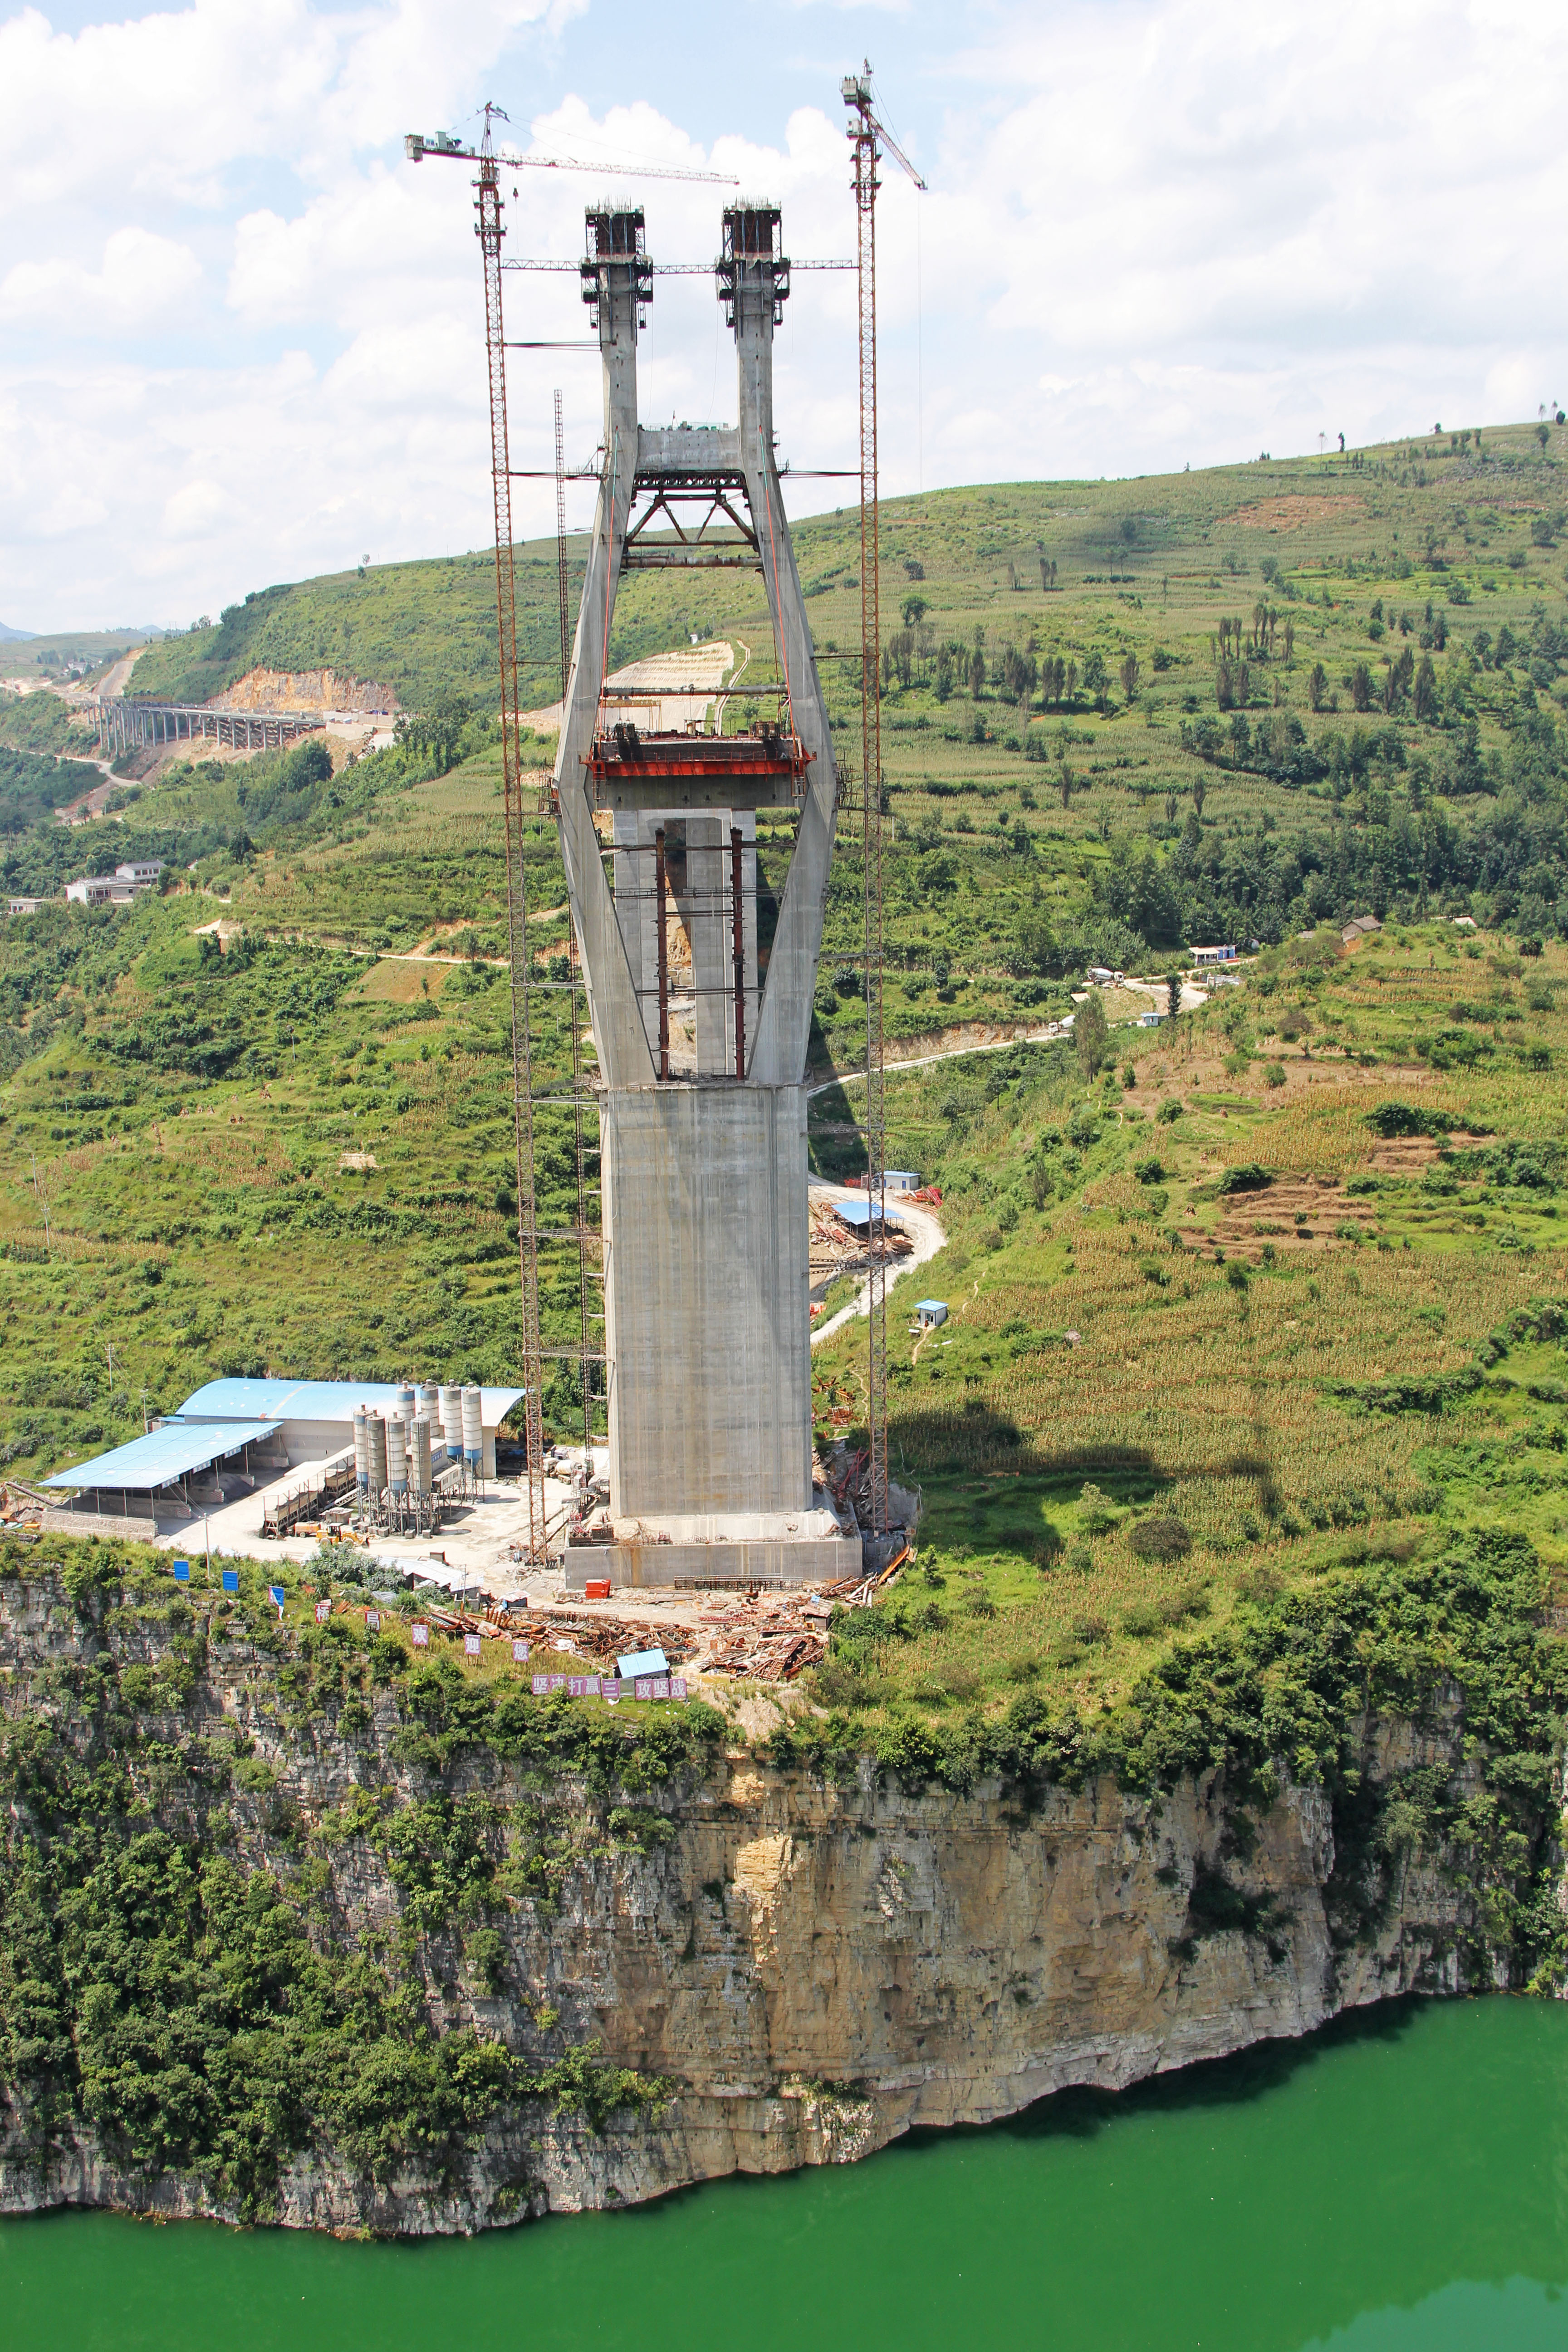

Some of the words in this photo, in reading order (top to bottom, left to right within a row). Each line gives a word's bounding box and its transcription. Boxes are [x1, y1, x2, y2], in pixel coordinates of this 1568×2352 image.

[316, 1605, 330, 1622] 桥
[367, 1613, 380, 1630] 局
[413, 1627, 427, 1643] 欢
[466, 1637, 480, 1654] 迎
[513, 1643, 528, 1660] 您
